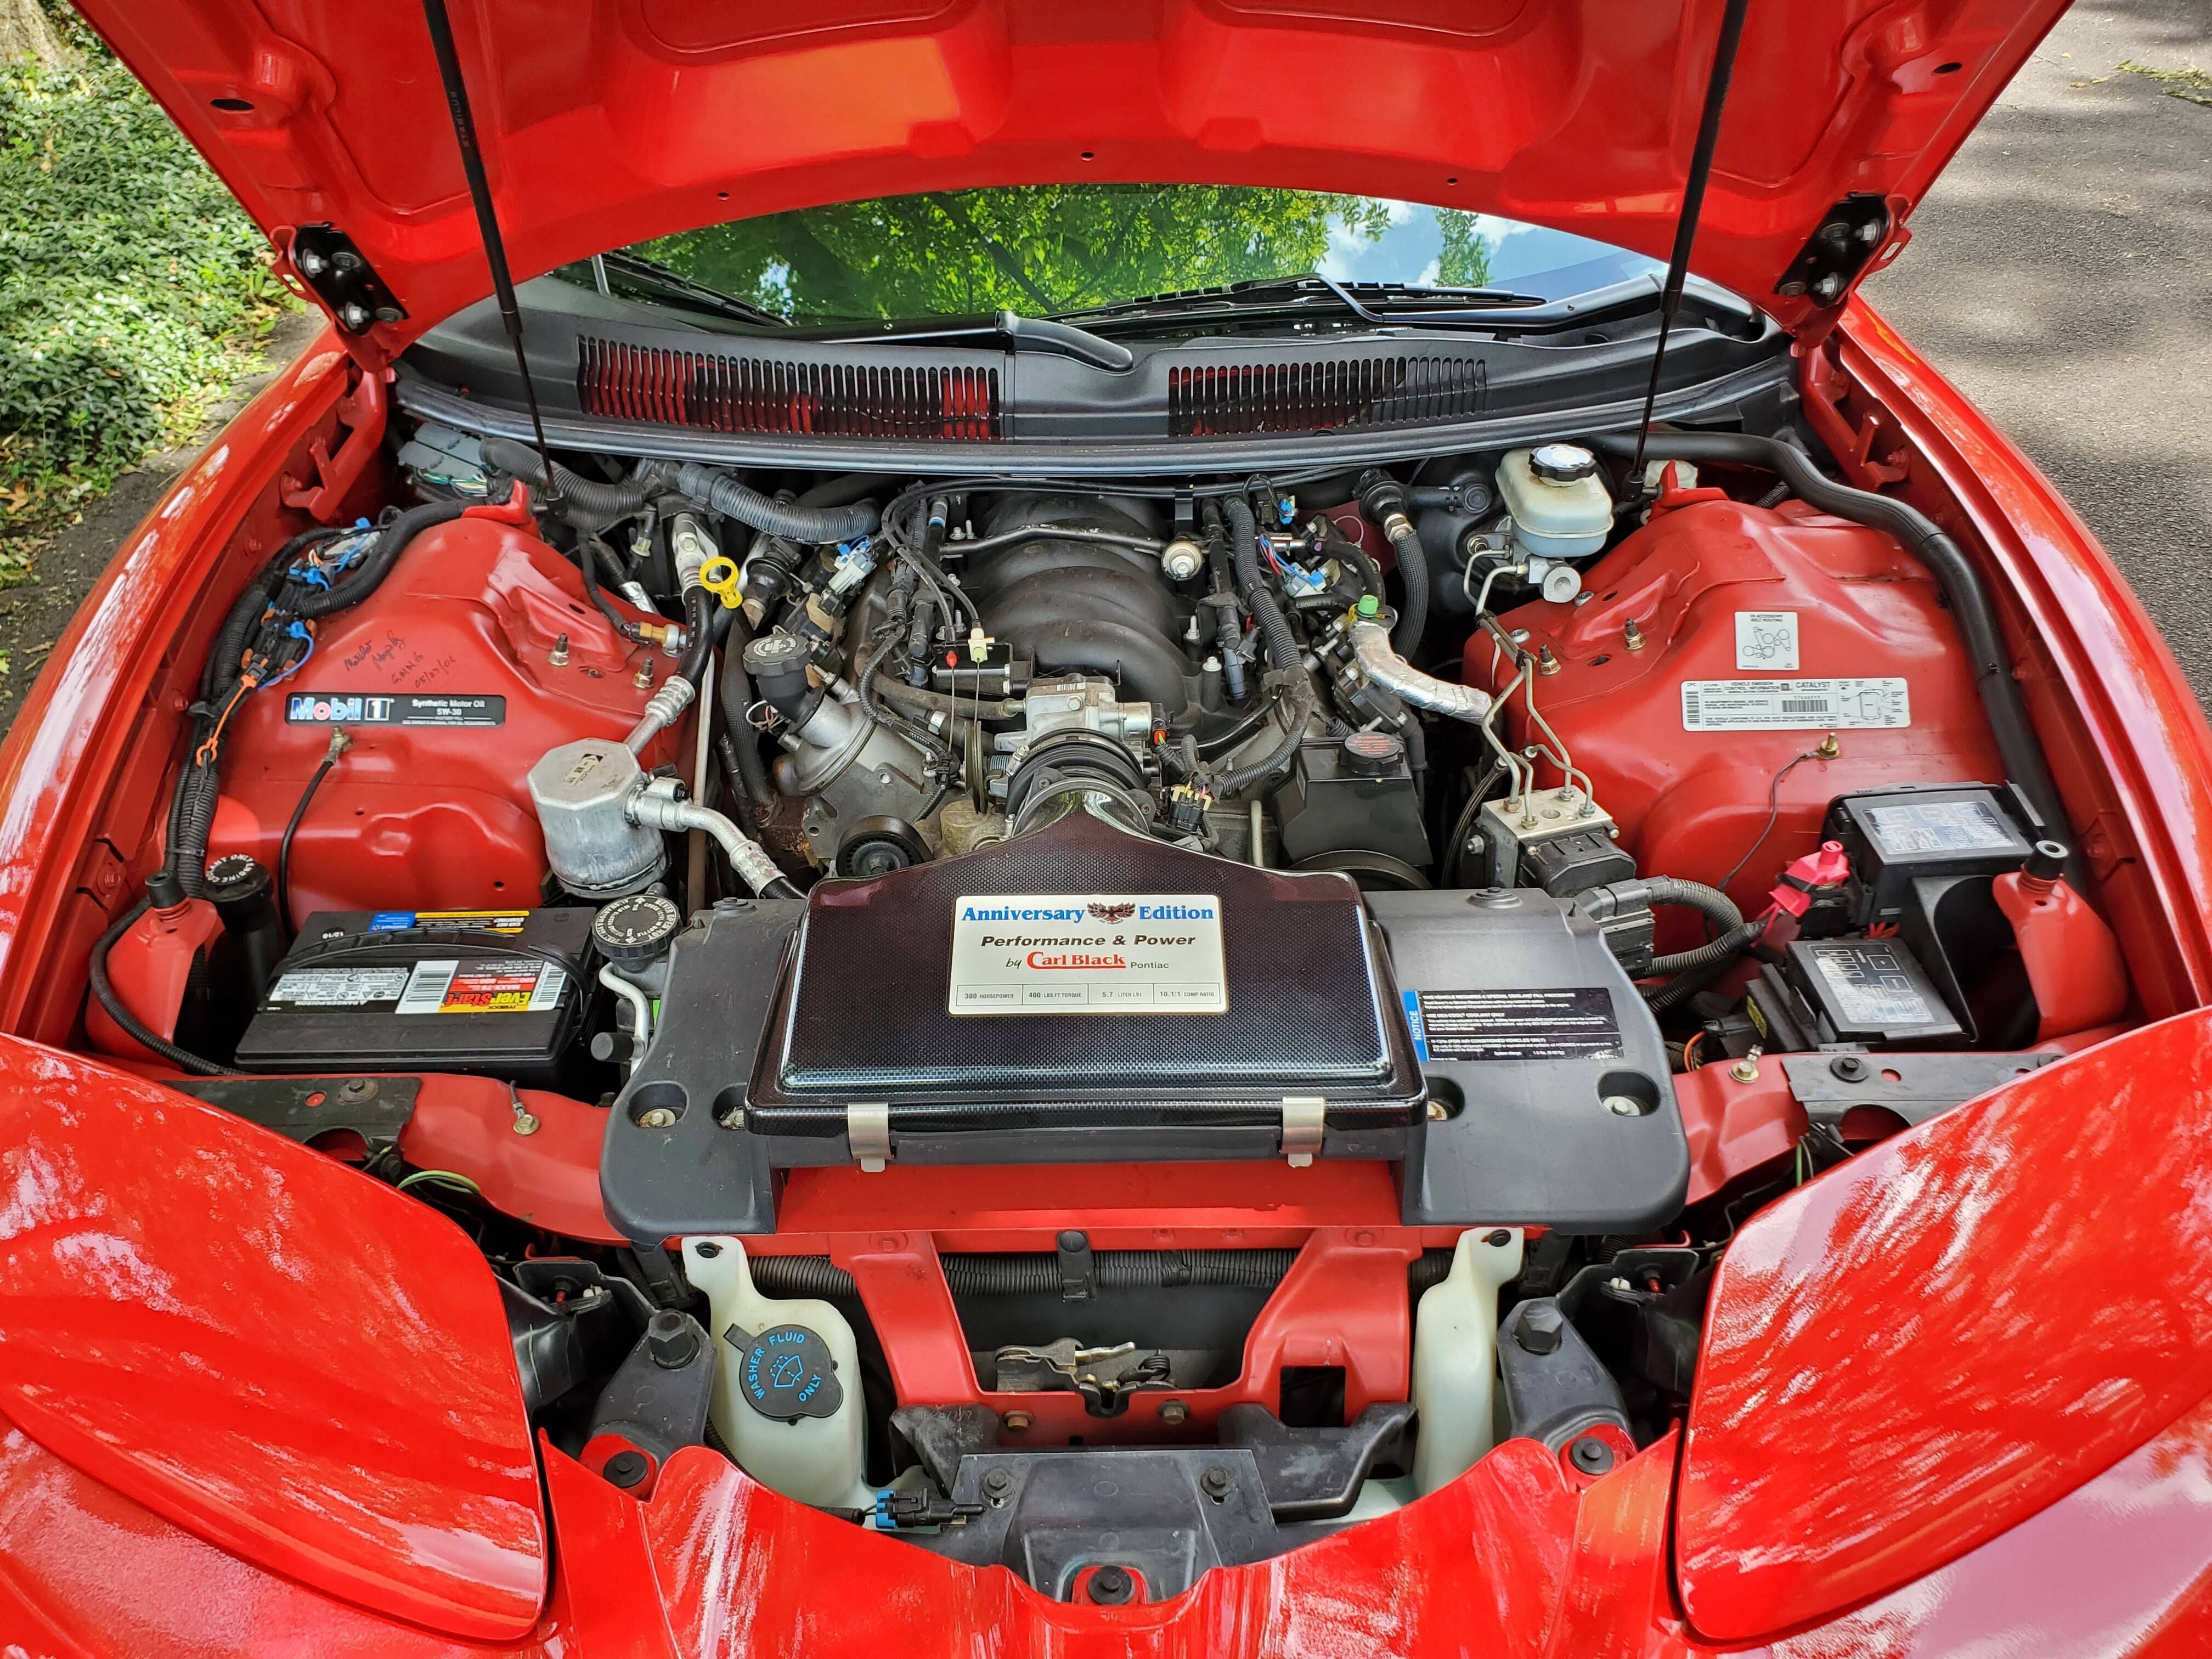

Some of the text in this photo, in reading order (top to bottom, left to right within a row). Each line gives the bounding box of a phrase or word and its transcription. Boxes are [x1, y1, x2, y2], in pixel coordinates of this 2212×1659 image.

[290, 697, 363, 720] Mobil
[412, 699, 448, 708] Synthetic
[449, 699, 472, 708] Motor
[961, 904, 1214, 923] Anniversary Edition
[980, 934, 1196, 947] Performance & Power
[1006, 951, 1169, 970] by Carl Black Pontiac
[444, 992, 532, 1007] EverStart
[1409, 1010, 1423, 1040] NOTICE
[747, 1332, 822, 1402] WASHER FLUID ONLY
